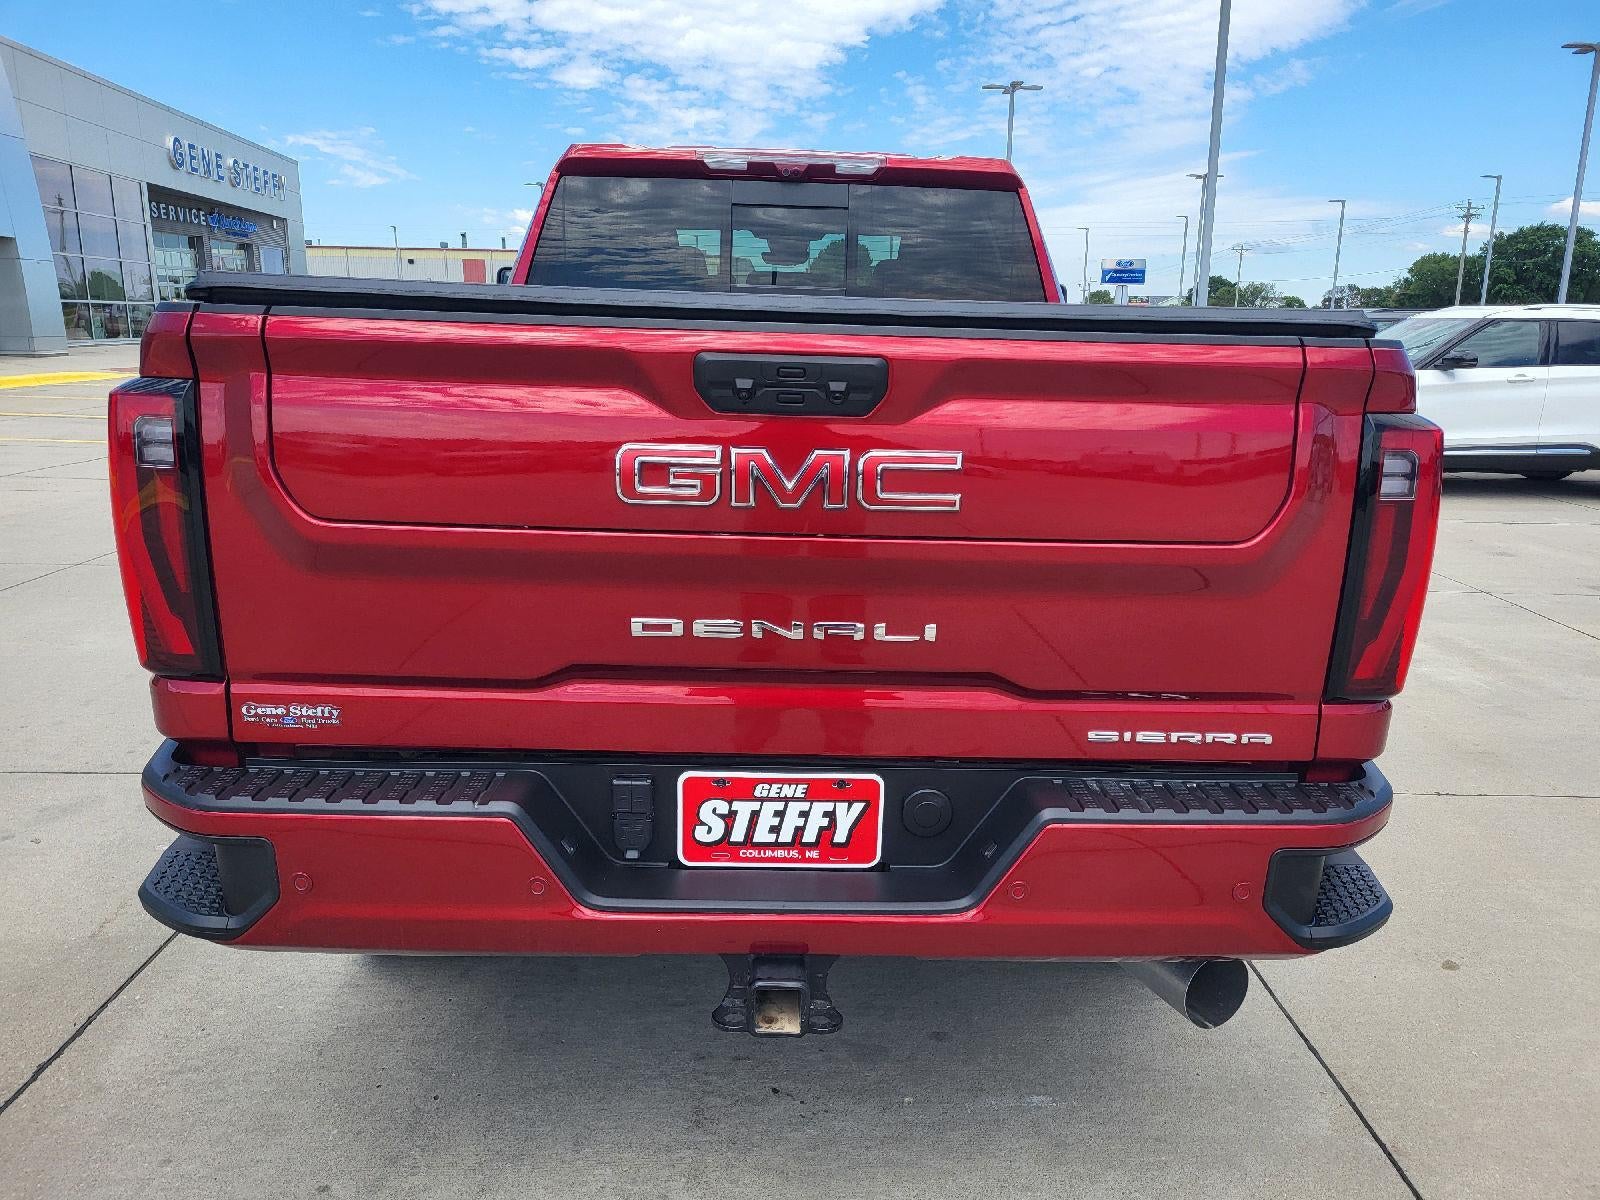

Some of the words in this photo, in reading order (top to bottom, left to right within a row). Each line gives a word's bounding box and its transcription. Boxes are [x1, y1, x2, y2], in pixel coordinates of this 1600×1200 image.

[169, 136, 225, 182] GENE
[230, 158, 287, 200] STEFFY
[150, 201, 207, 226] SERVICE
[615, 443, 963, 511] GMC
[630, 617, 937, 642] DENALI
[241, 704, 287, 716] Gene
[289, 705, 341, 719] Steffy
[1087, 731, 1273, 745] SIERRA
[752, 783, 809, 799] GENE
[692, 798, 871, 847] STEFFY
[739, 849, 801, 860] COLUMBUS,
[805, 850, 820, 859] NE
